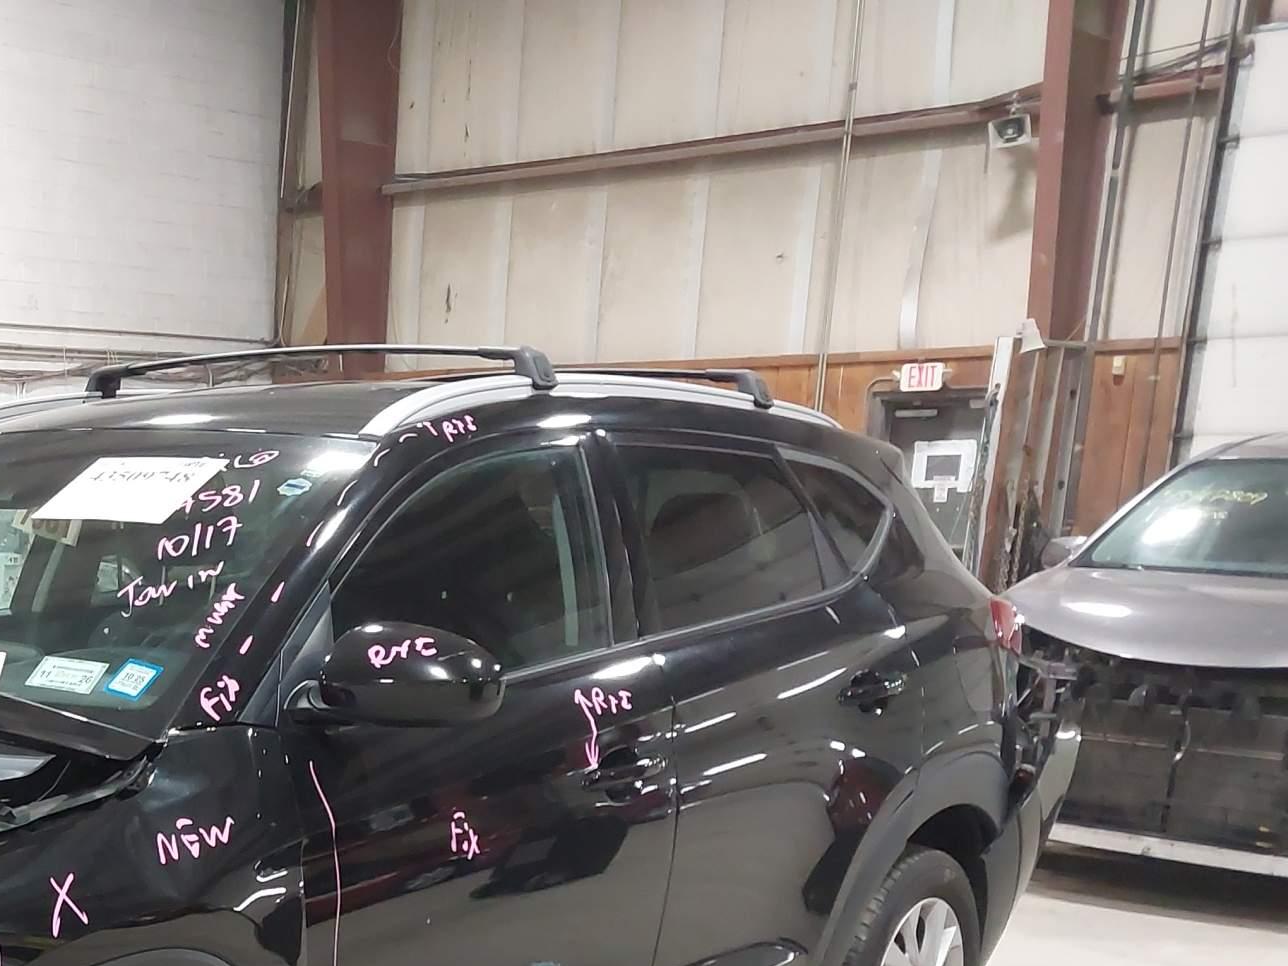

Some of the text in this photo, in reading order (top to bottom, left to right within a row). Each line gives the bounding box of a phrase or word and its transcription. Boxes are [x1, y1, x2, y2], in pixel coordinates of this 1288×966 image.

[908, 365, 938, 388] EXIT
[157, 516, 243, 560] 10/17
[199, 675, 241, 722] Fix
[156, 816, 235, 865] NEW
[450, 811, 481, 860] Fix
